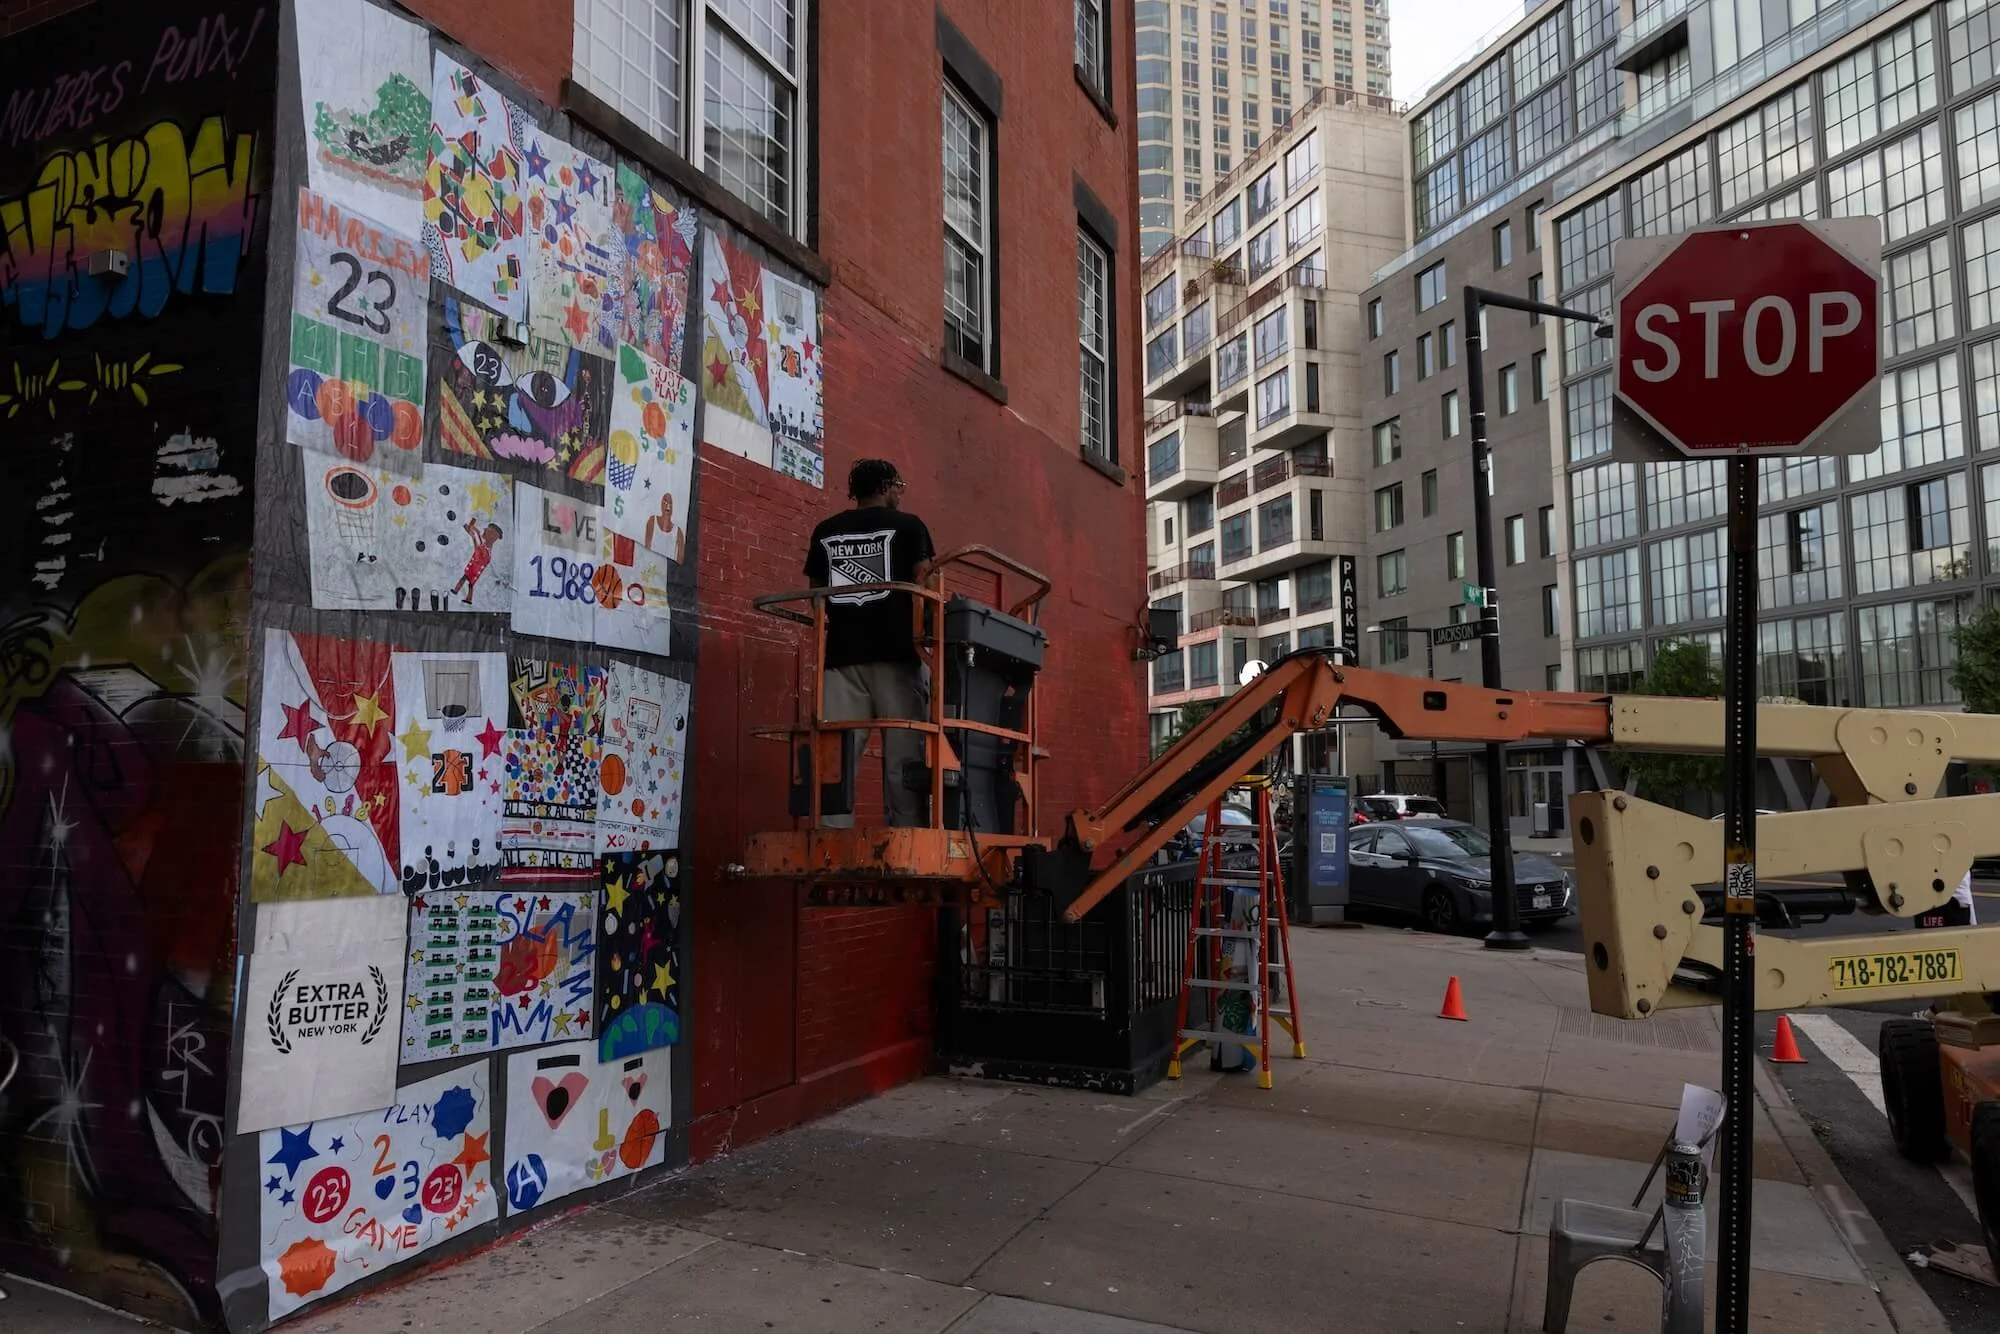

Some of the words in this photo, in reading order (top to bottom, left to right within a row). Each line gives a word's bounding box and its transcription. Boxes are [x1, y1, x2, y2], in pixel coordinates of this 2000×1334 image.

[298, 187, 431, 283] HARLEM
[327, 252, 397, 335] 23
[1631, 291, 1863, 383] STOP
[476, 353, 499, 380] 23
[651, 361, 683, 390] JUST
[831, 544, 855, 557] NEW
[857, 541, 883, 555] YORK
[530, 555, 595, 604] 1988
[1343, 560, 1355, 628] PARK
[1435, 624, 1474, 645] JACKSON
[1922, 915, 1945, 927] LIFE
[1835, 951, 1957, 986] 718-782-7887
[296, 982, 365, 1003] EXTRA
[288, 1002, 369, 1025] BUTTER
[298, 1026, 325, 1038] NEW
[328, 1023, 357, 1035] YORK
[383, 1103, 433, 1124] PLAY
[344, 1208, 418, 1252] GAME
